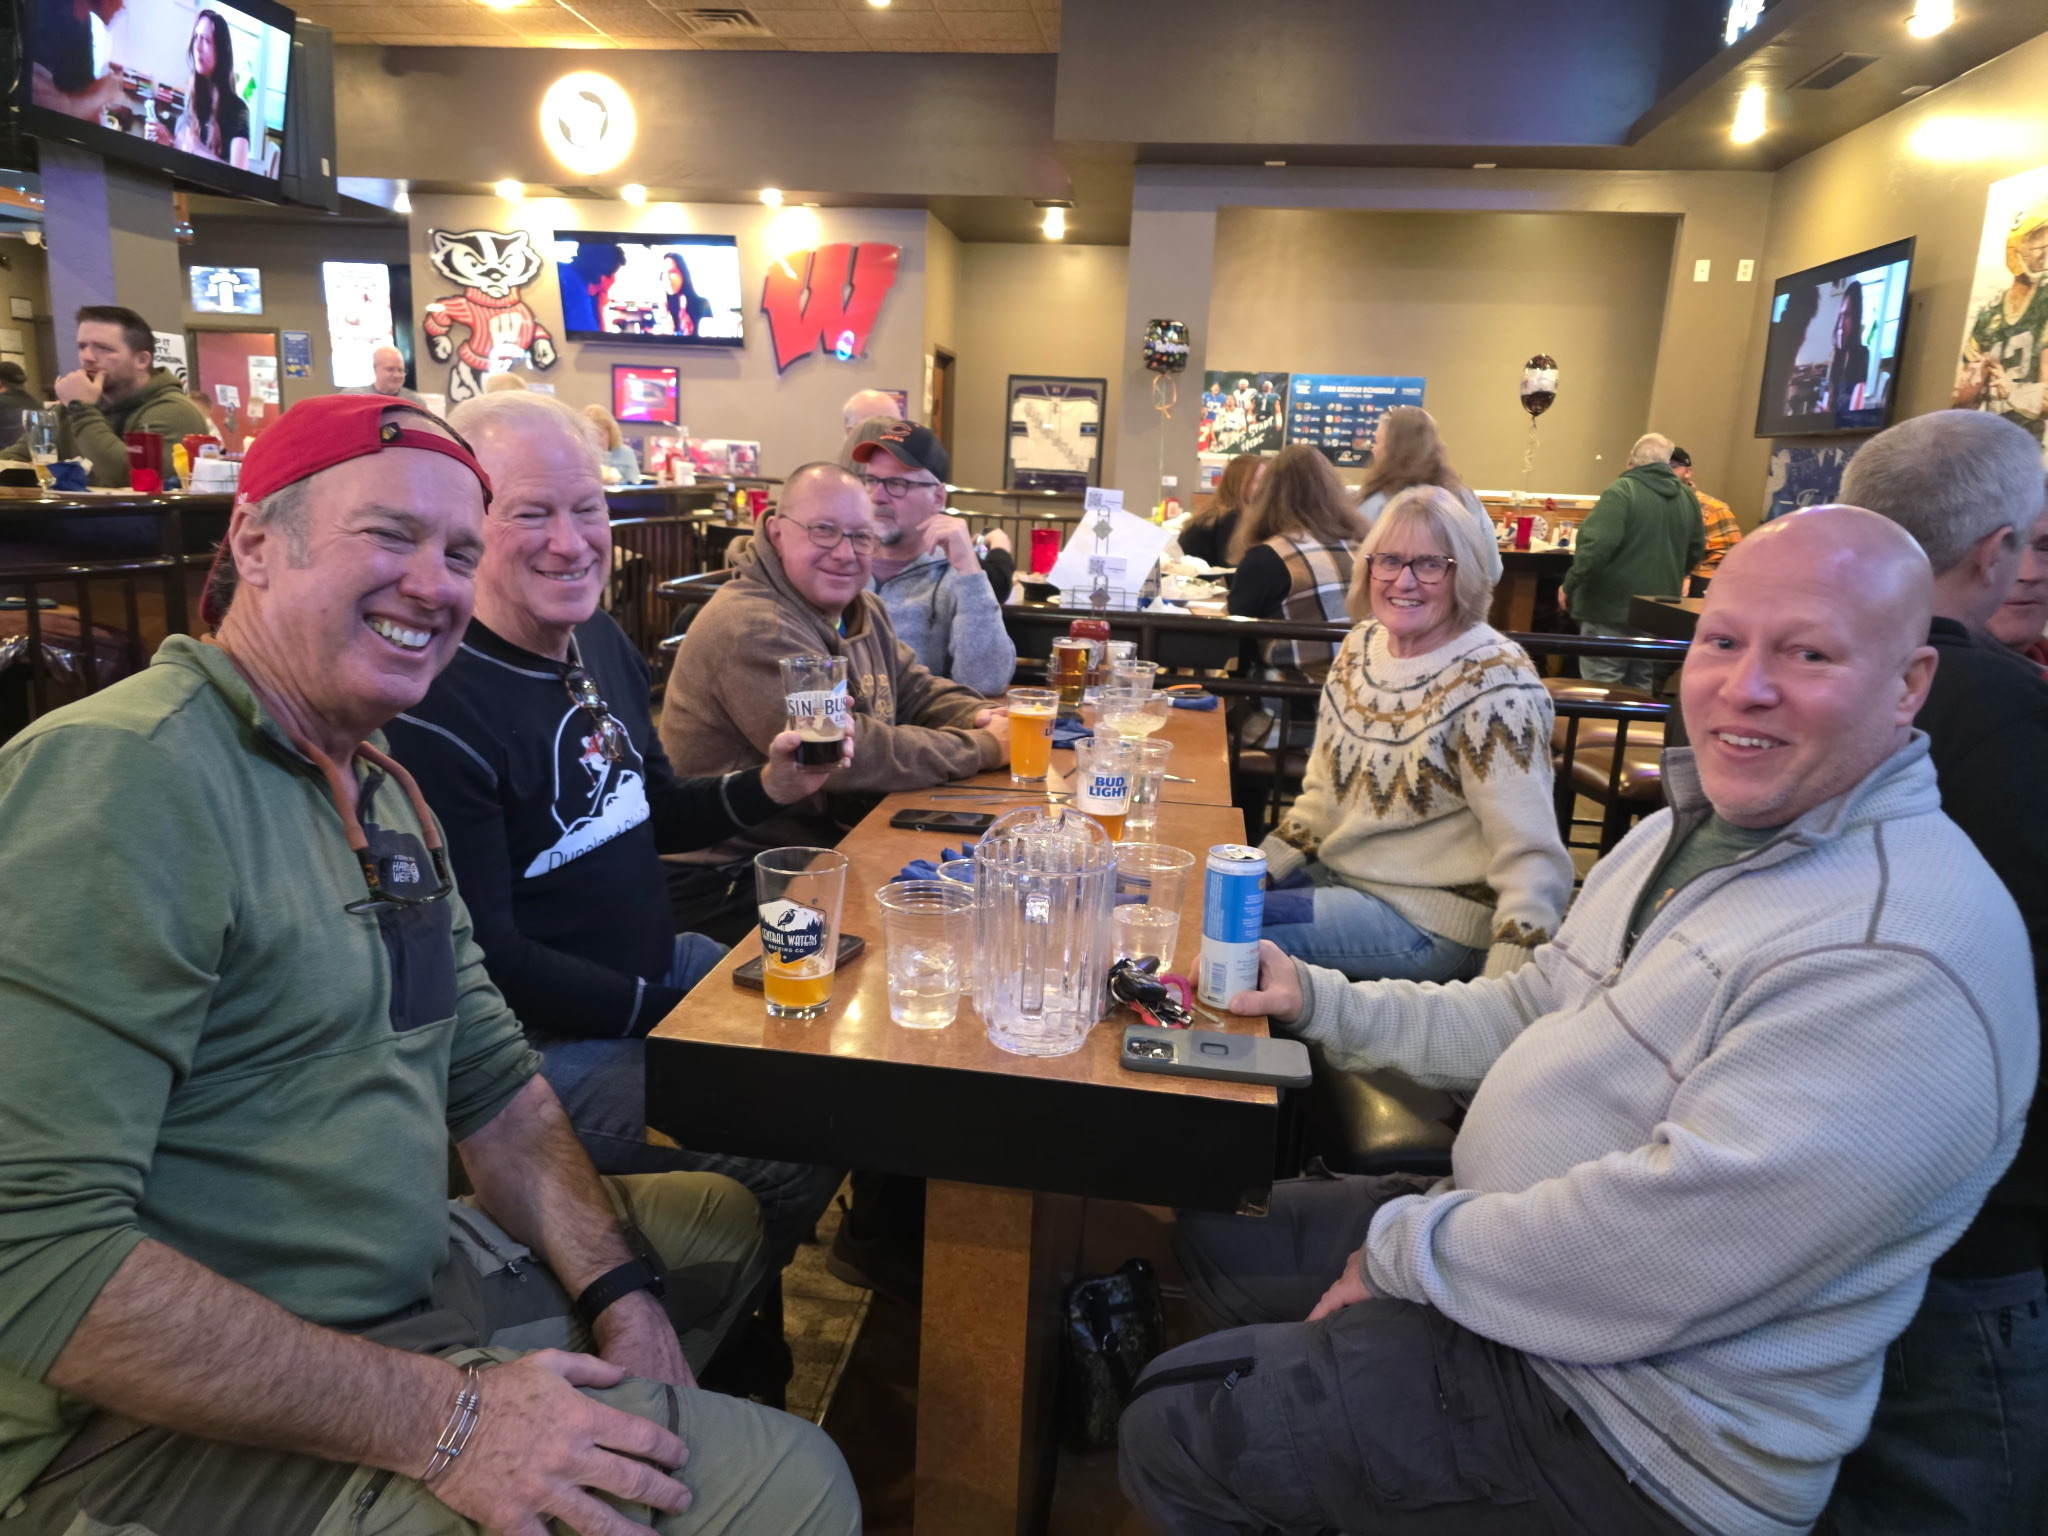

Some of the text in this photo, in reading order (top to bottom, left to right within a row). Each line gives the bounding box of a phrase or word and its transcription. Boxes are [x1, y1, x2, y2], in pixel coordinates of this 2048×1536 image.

[761, 242, 900, 375] W
[1095, 776, 1125, 787] BUD
[1089, 786, 1128, 797] LIGHT
[787, 934, 818, 947] WATERS
